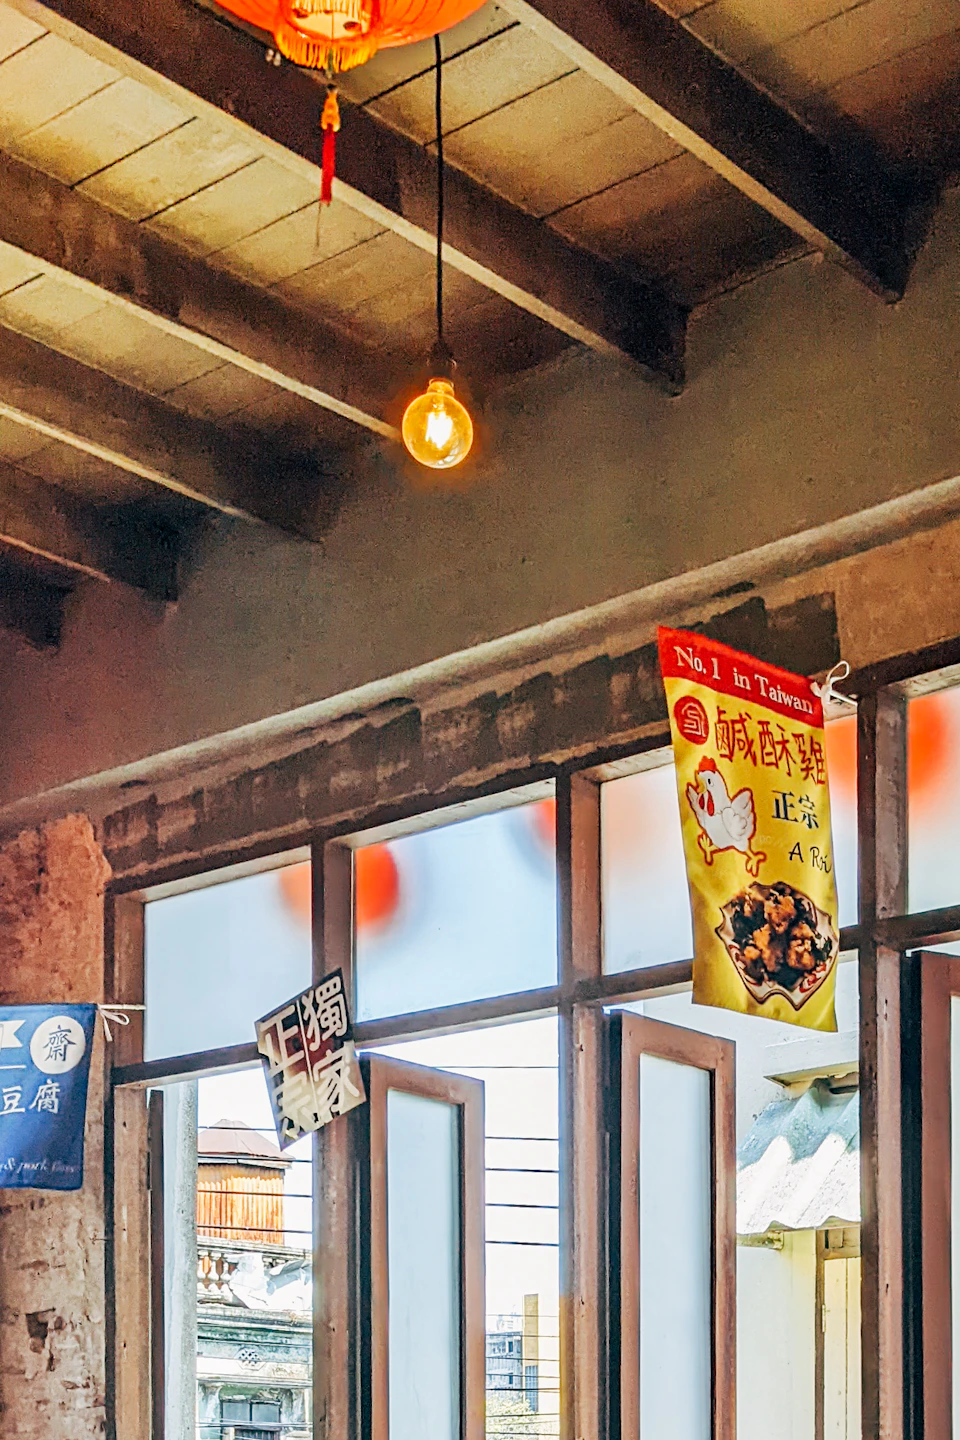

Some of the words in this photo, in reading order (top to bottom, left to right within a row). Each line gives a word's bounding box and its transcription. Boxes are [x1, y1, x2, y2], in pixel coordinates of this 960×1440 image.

[733, 667, 751, 690] in
[753, 673, 813, 714] Taiwan
[714, 705, 825, 785] 鹹酥雞
[771, 789, 819, 829] 正宗
[788, 841, 804, 863] A
[302, 976, 360, 1120] 獨家
[0, 1078, 61, 1115] 豆腐
